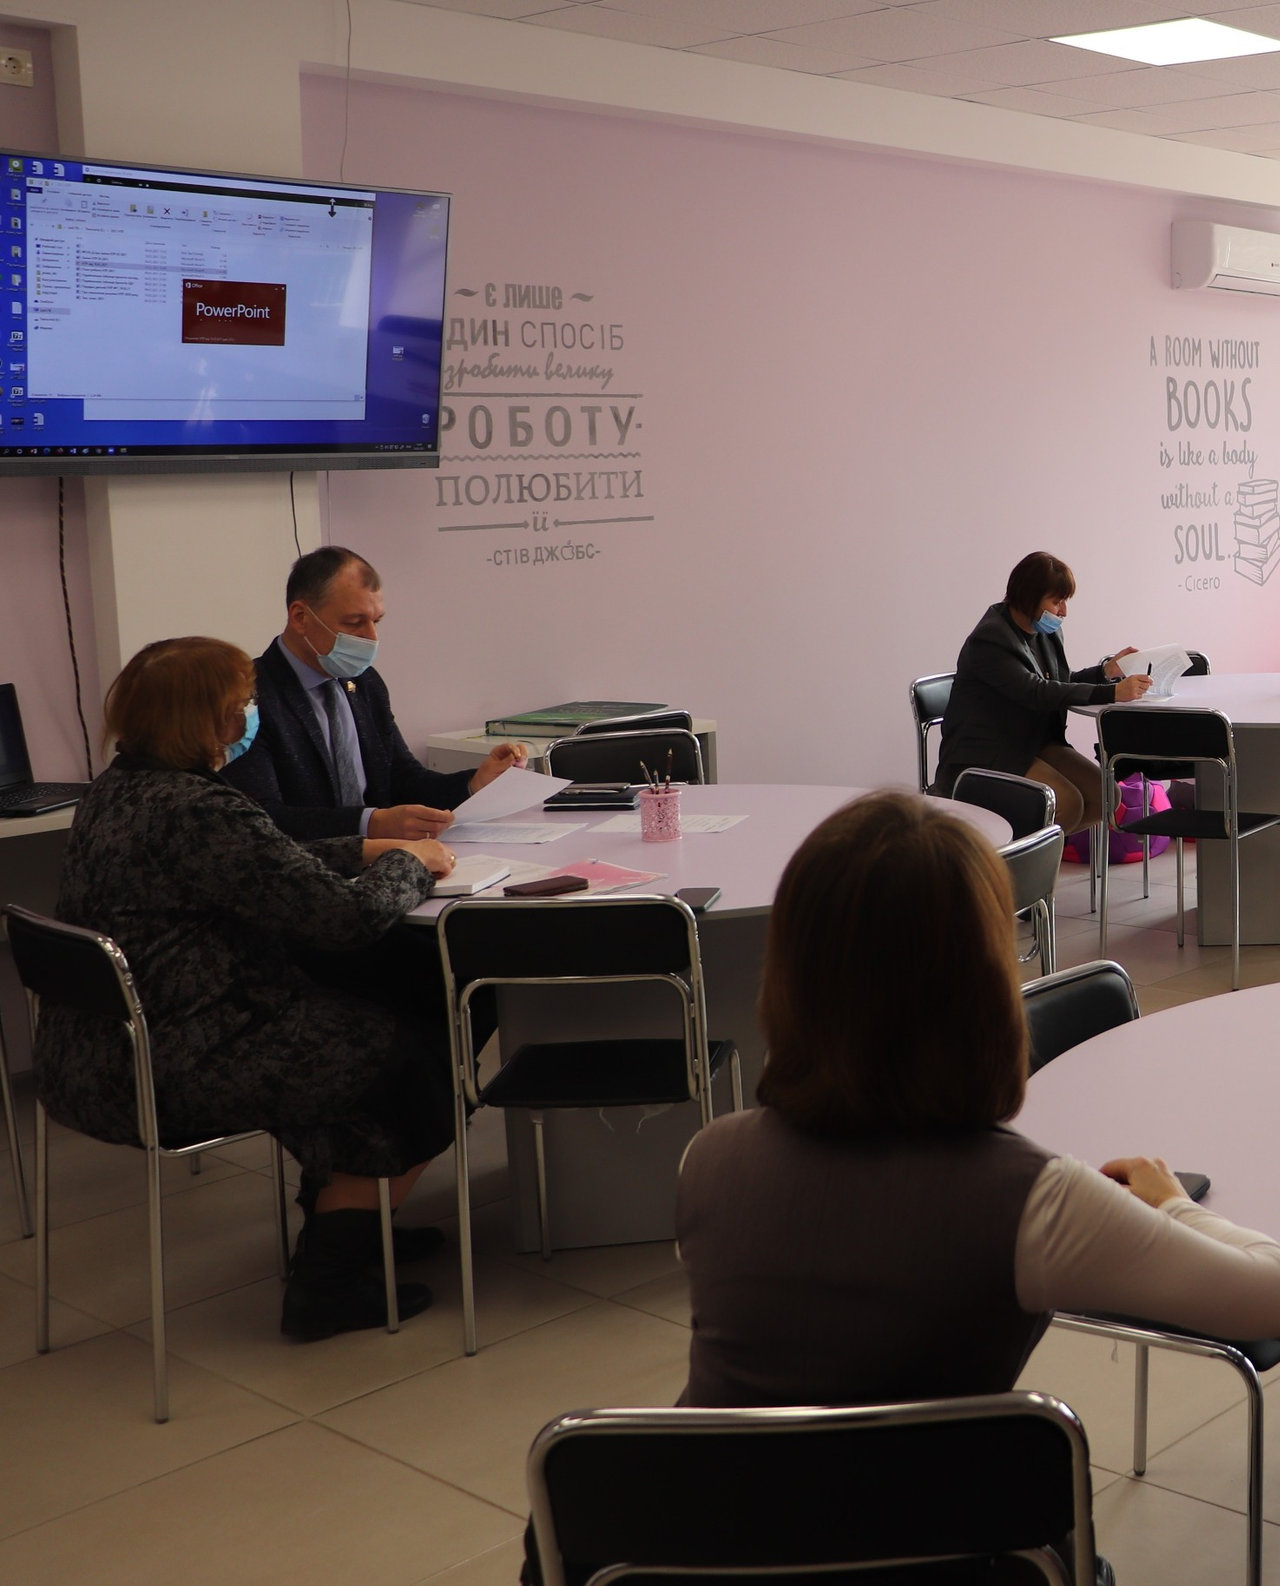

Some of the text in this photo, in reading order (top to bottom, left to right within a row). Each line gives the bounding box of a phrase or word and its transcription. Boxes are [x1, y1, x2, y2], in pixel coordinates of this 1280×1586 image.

[196, 302, 271, 319] PowerPoint
[446, 318, 624, 351] ДИН СПОСІБ
[1150, 335, 1260, 369] A ROOM WITHOUT
[444, 352, 614, 390] зробити велику
[1166, 376, 1252, 432] BOOKS
[1160, 440, 1258, 479] is like a body
[435, 470, 644, 507] ПОЛЮБИТИ
[1161, 481, 1234, 509] without a
[1174, 523, 1231, 564] SOUL.
